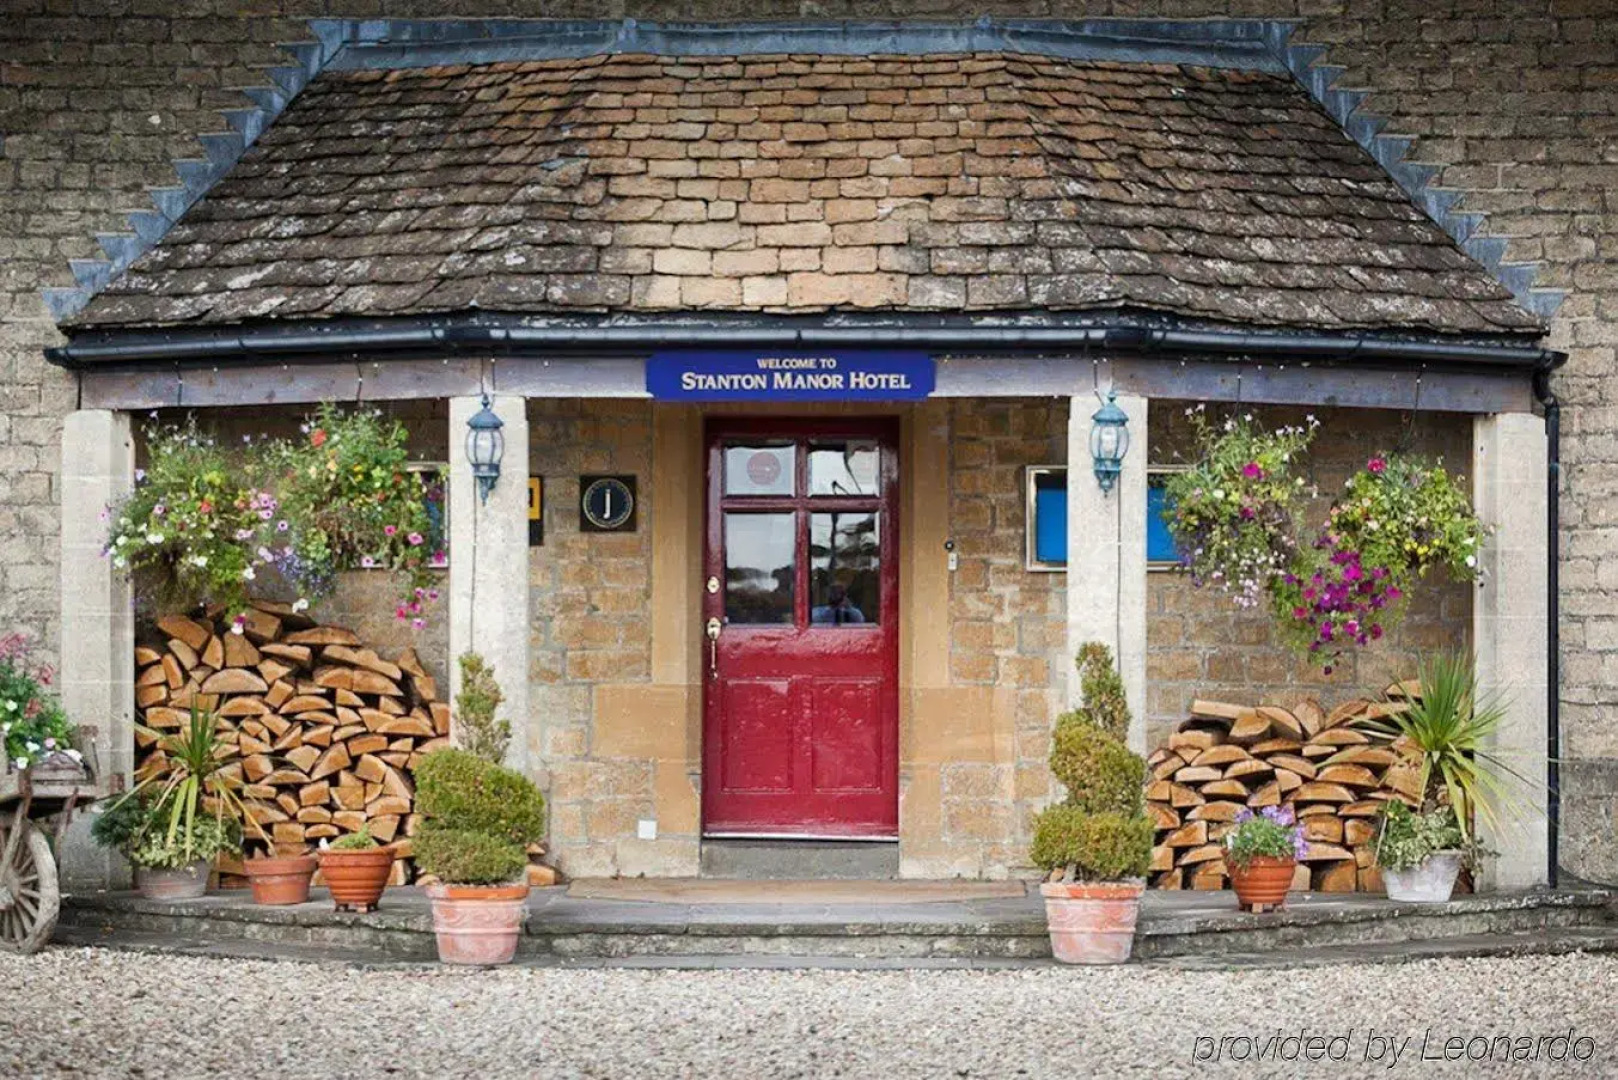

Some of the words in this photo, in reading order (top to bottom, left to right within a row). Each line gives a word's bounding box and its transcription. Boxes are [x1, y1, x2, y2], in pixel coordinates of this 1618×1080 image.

[757, 358, 816, 369] WELCOME
[820, 358, 836, 369] TO
[681, 372, 767, 390] STANTON
[773, 373, 843, 390] MANOR
[849, 372, 911, 390] HOTEL
